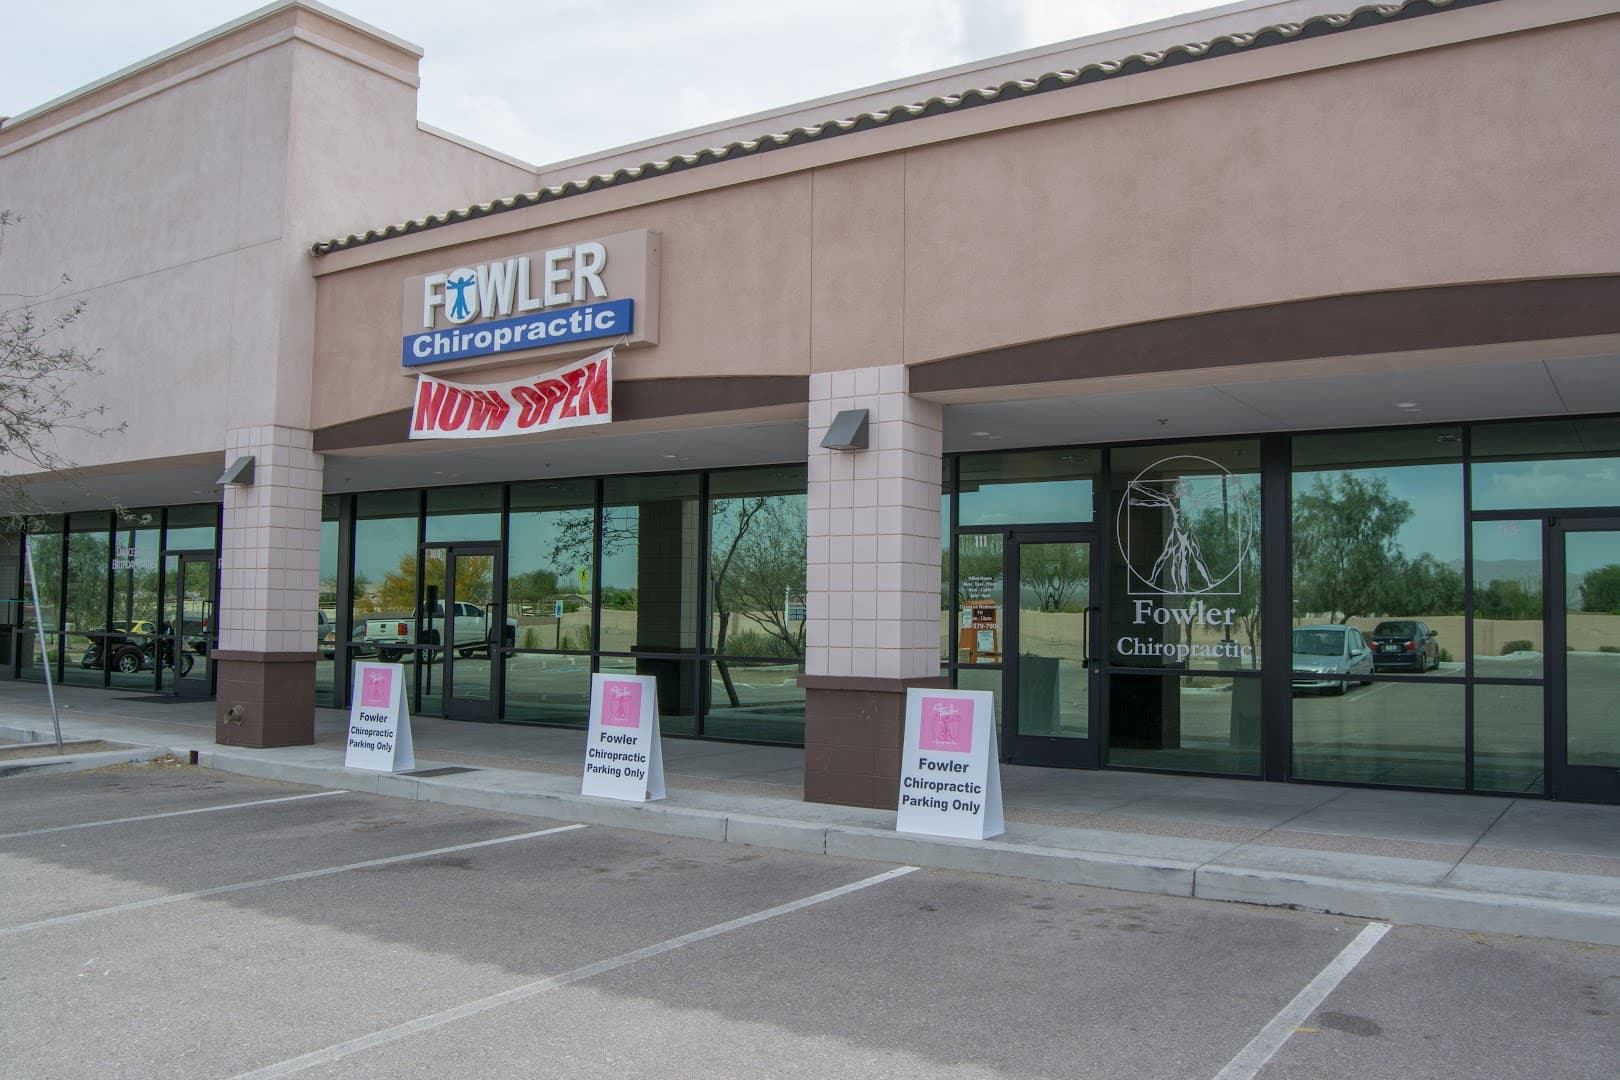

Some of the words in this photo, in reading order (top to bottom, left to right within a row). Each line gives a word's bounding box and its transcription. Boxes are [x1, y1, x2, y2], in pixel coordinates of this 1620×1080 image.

[423, 242, 608, 328] FOWLER
[412, 308, 616, 358] Chiropractic
[414, 381, 510, 431] NOW
[511, 358, 608, 429] OPEN
[975, 535, 987, 547] 111
[1132, 599, 1236, 625] Fowler
[1116, 637, 1252, 663] Chiropractic
[359, 712, 388, 723] Fowler
[350, 726, 394, 738] Chiropractic
[600, 732, 638, 745] Fowler
[349, 739, 375, 751] Parking
[376, 742, 393, 752] Only
[588, 748, 646, 763] Chiropractic
[586, 763, 621, 778] Parking
[624, 767, 645, 780] Only
[918, 757, 969, 773] Fowler
[903, 776, 982, 794] Chiropractic
[902, 794, 948, 812] Parking
[952, 799, 981, 815] Only
